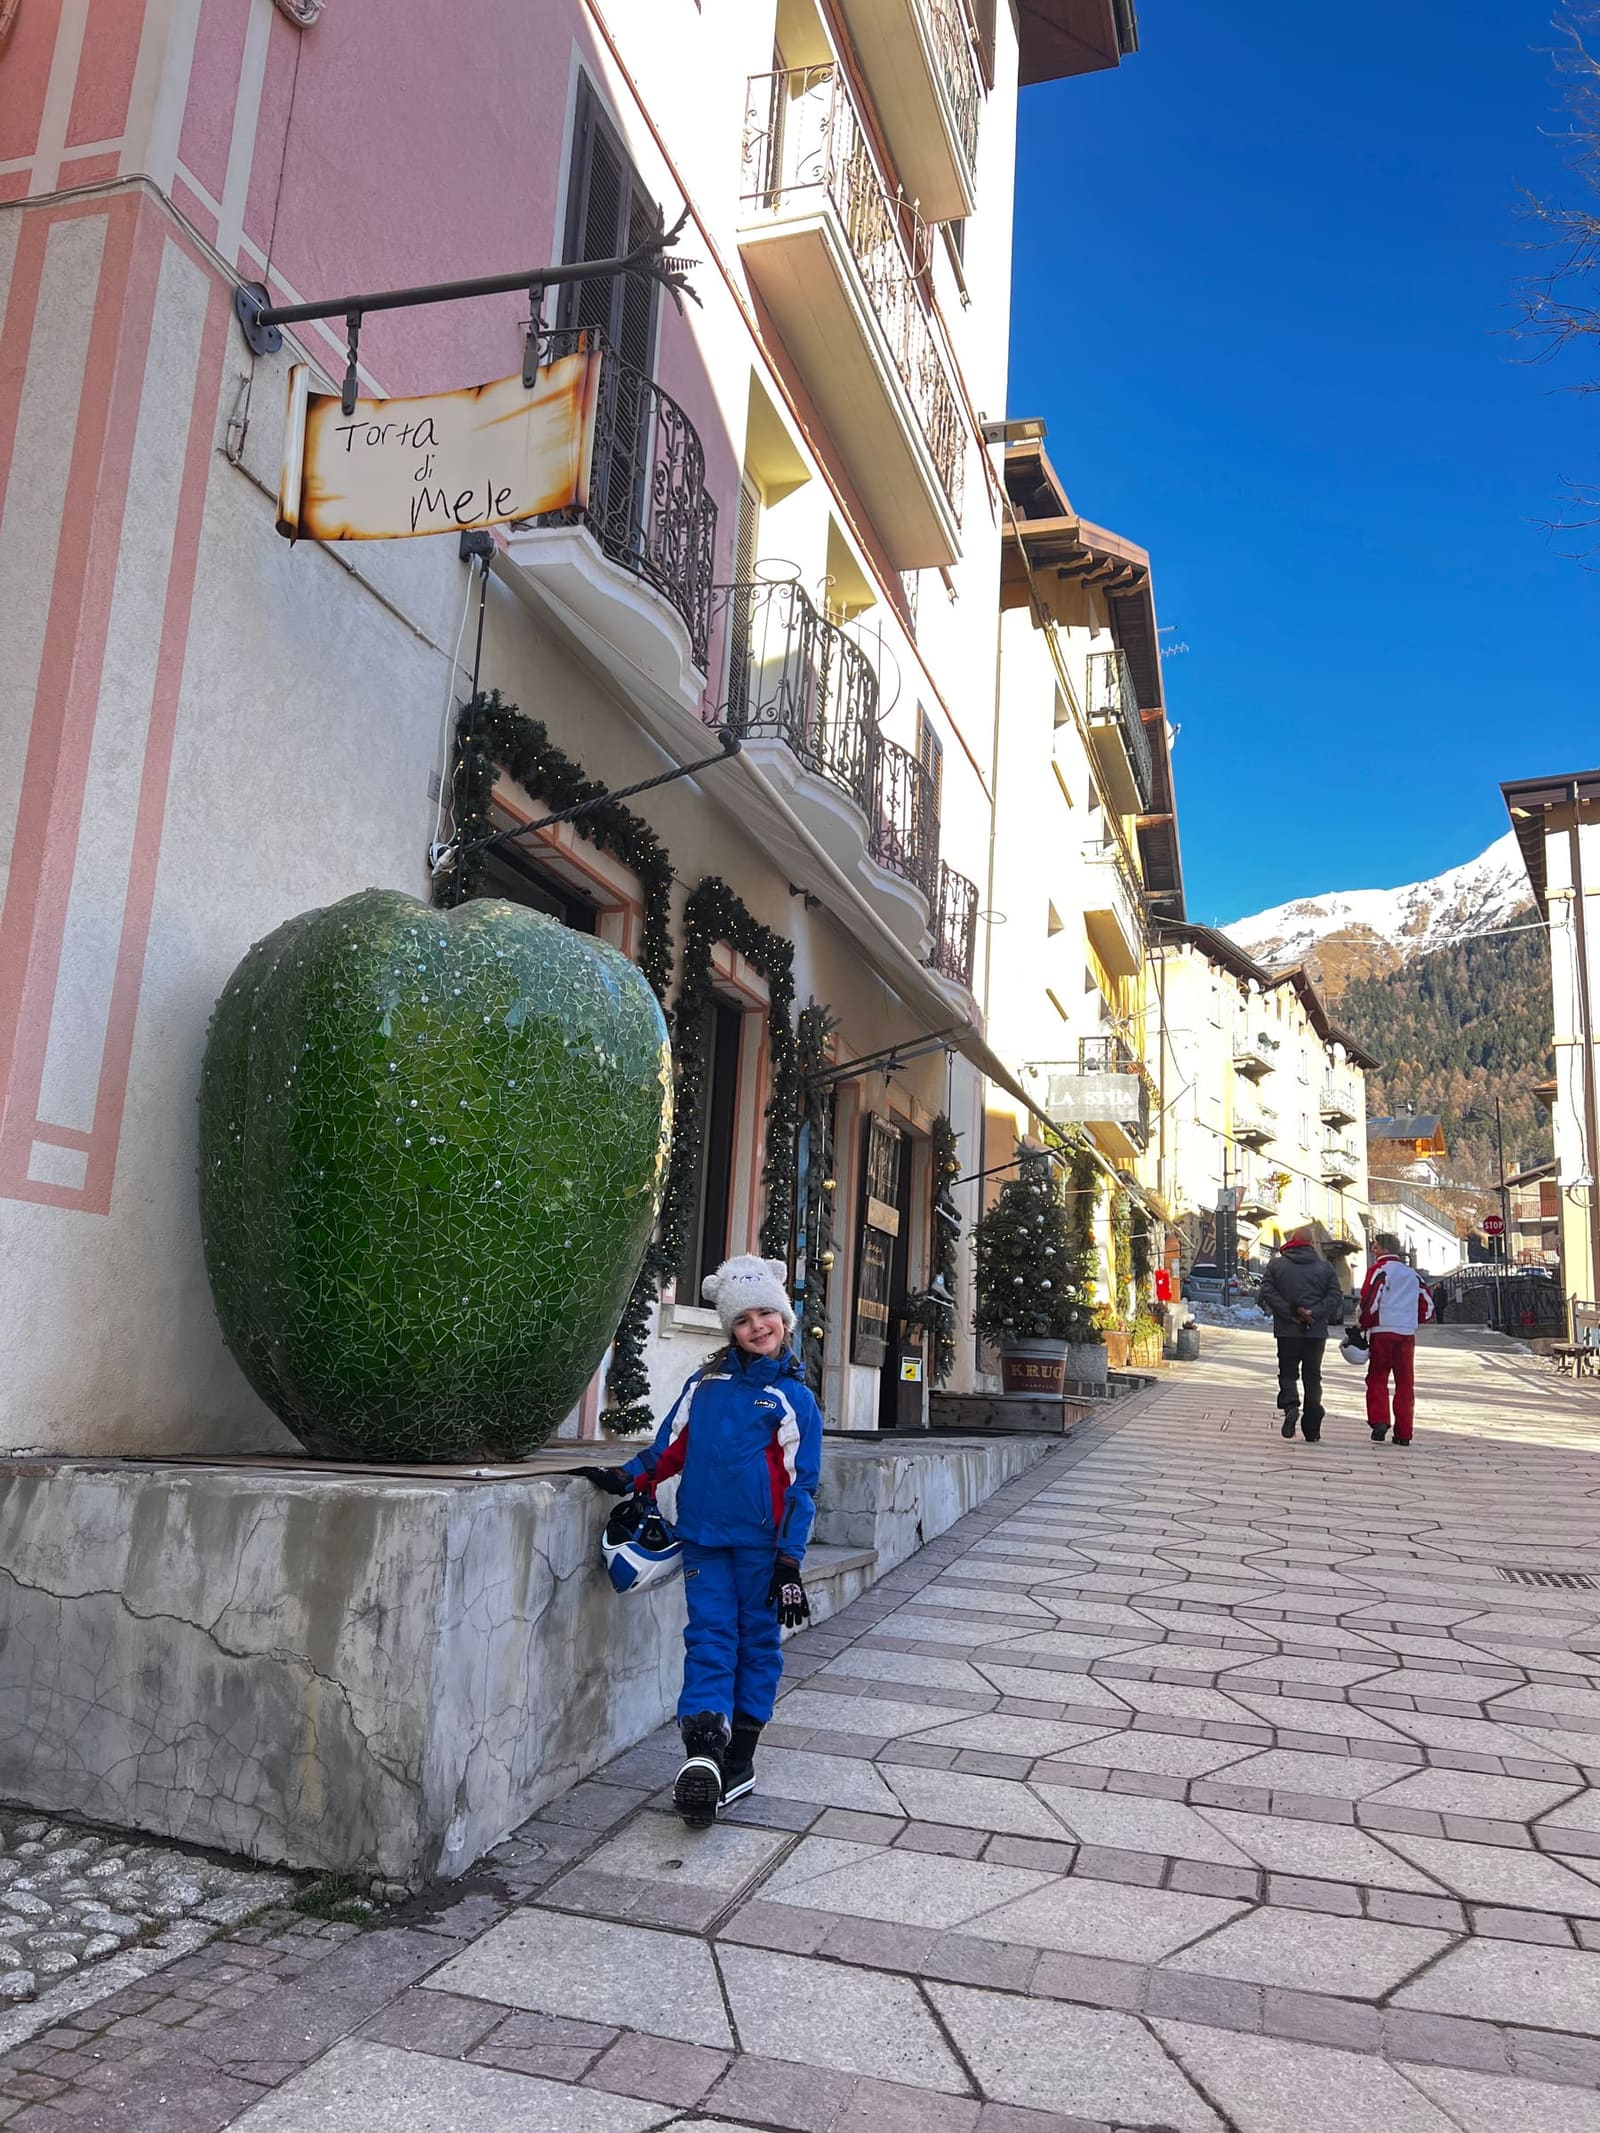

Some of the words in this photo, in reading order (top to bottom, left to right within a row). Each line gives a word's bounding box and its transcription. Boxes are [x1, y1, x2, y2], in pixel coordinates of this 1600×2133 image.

[335, 417, 439, 453] Torta
[414, 454, 435, 481] di
[410, 480, 520, 533] Mele
[1049, 1091, 1075, 1105] LA
[1484, 1221, 1504, 1230] STOP
[1011, 1364, 1063, 1378] KRUG
